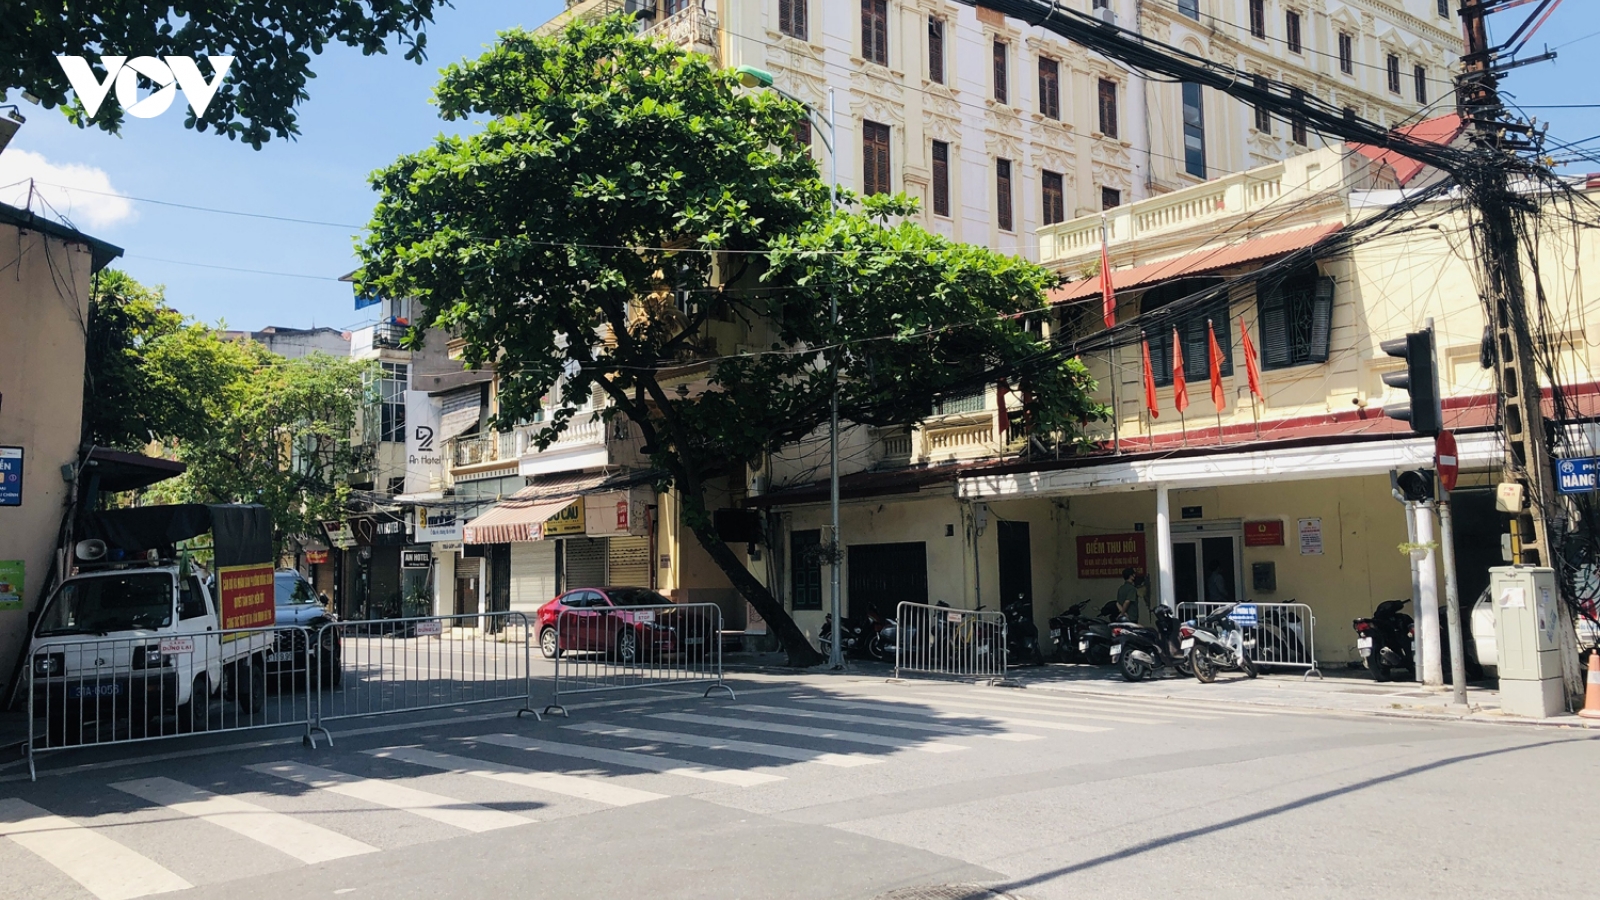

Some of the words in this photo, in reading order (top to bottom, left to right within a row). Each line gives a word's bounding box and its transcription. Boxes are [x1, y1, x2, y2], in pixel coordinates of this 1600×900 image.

[409, 455, 419, 464] An
[421, 455, 441, 464] Hotel
[1562, 473, 1595, 487] HÀNG
[384, 521, 399, 534] HOTEL
[1106, 541, 1121, 553] THU
